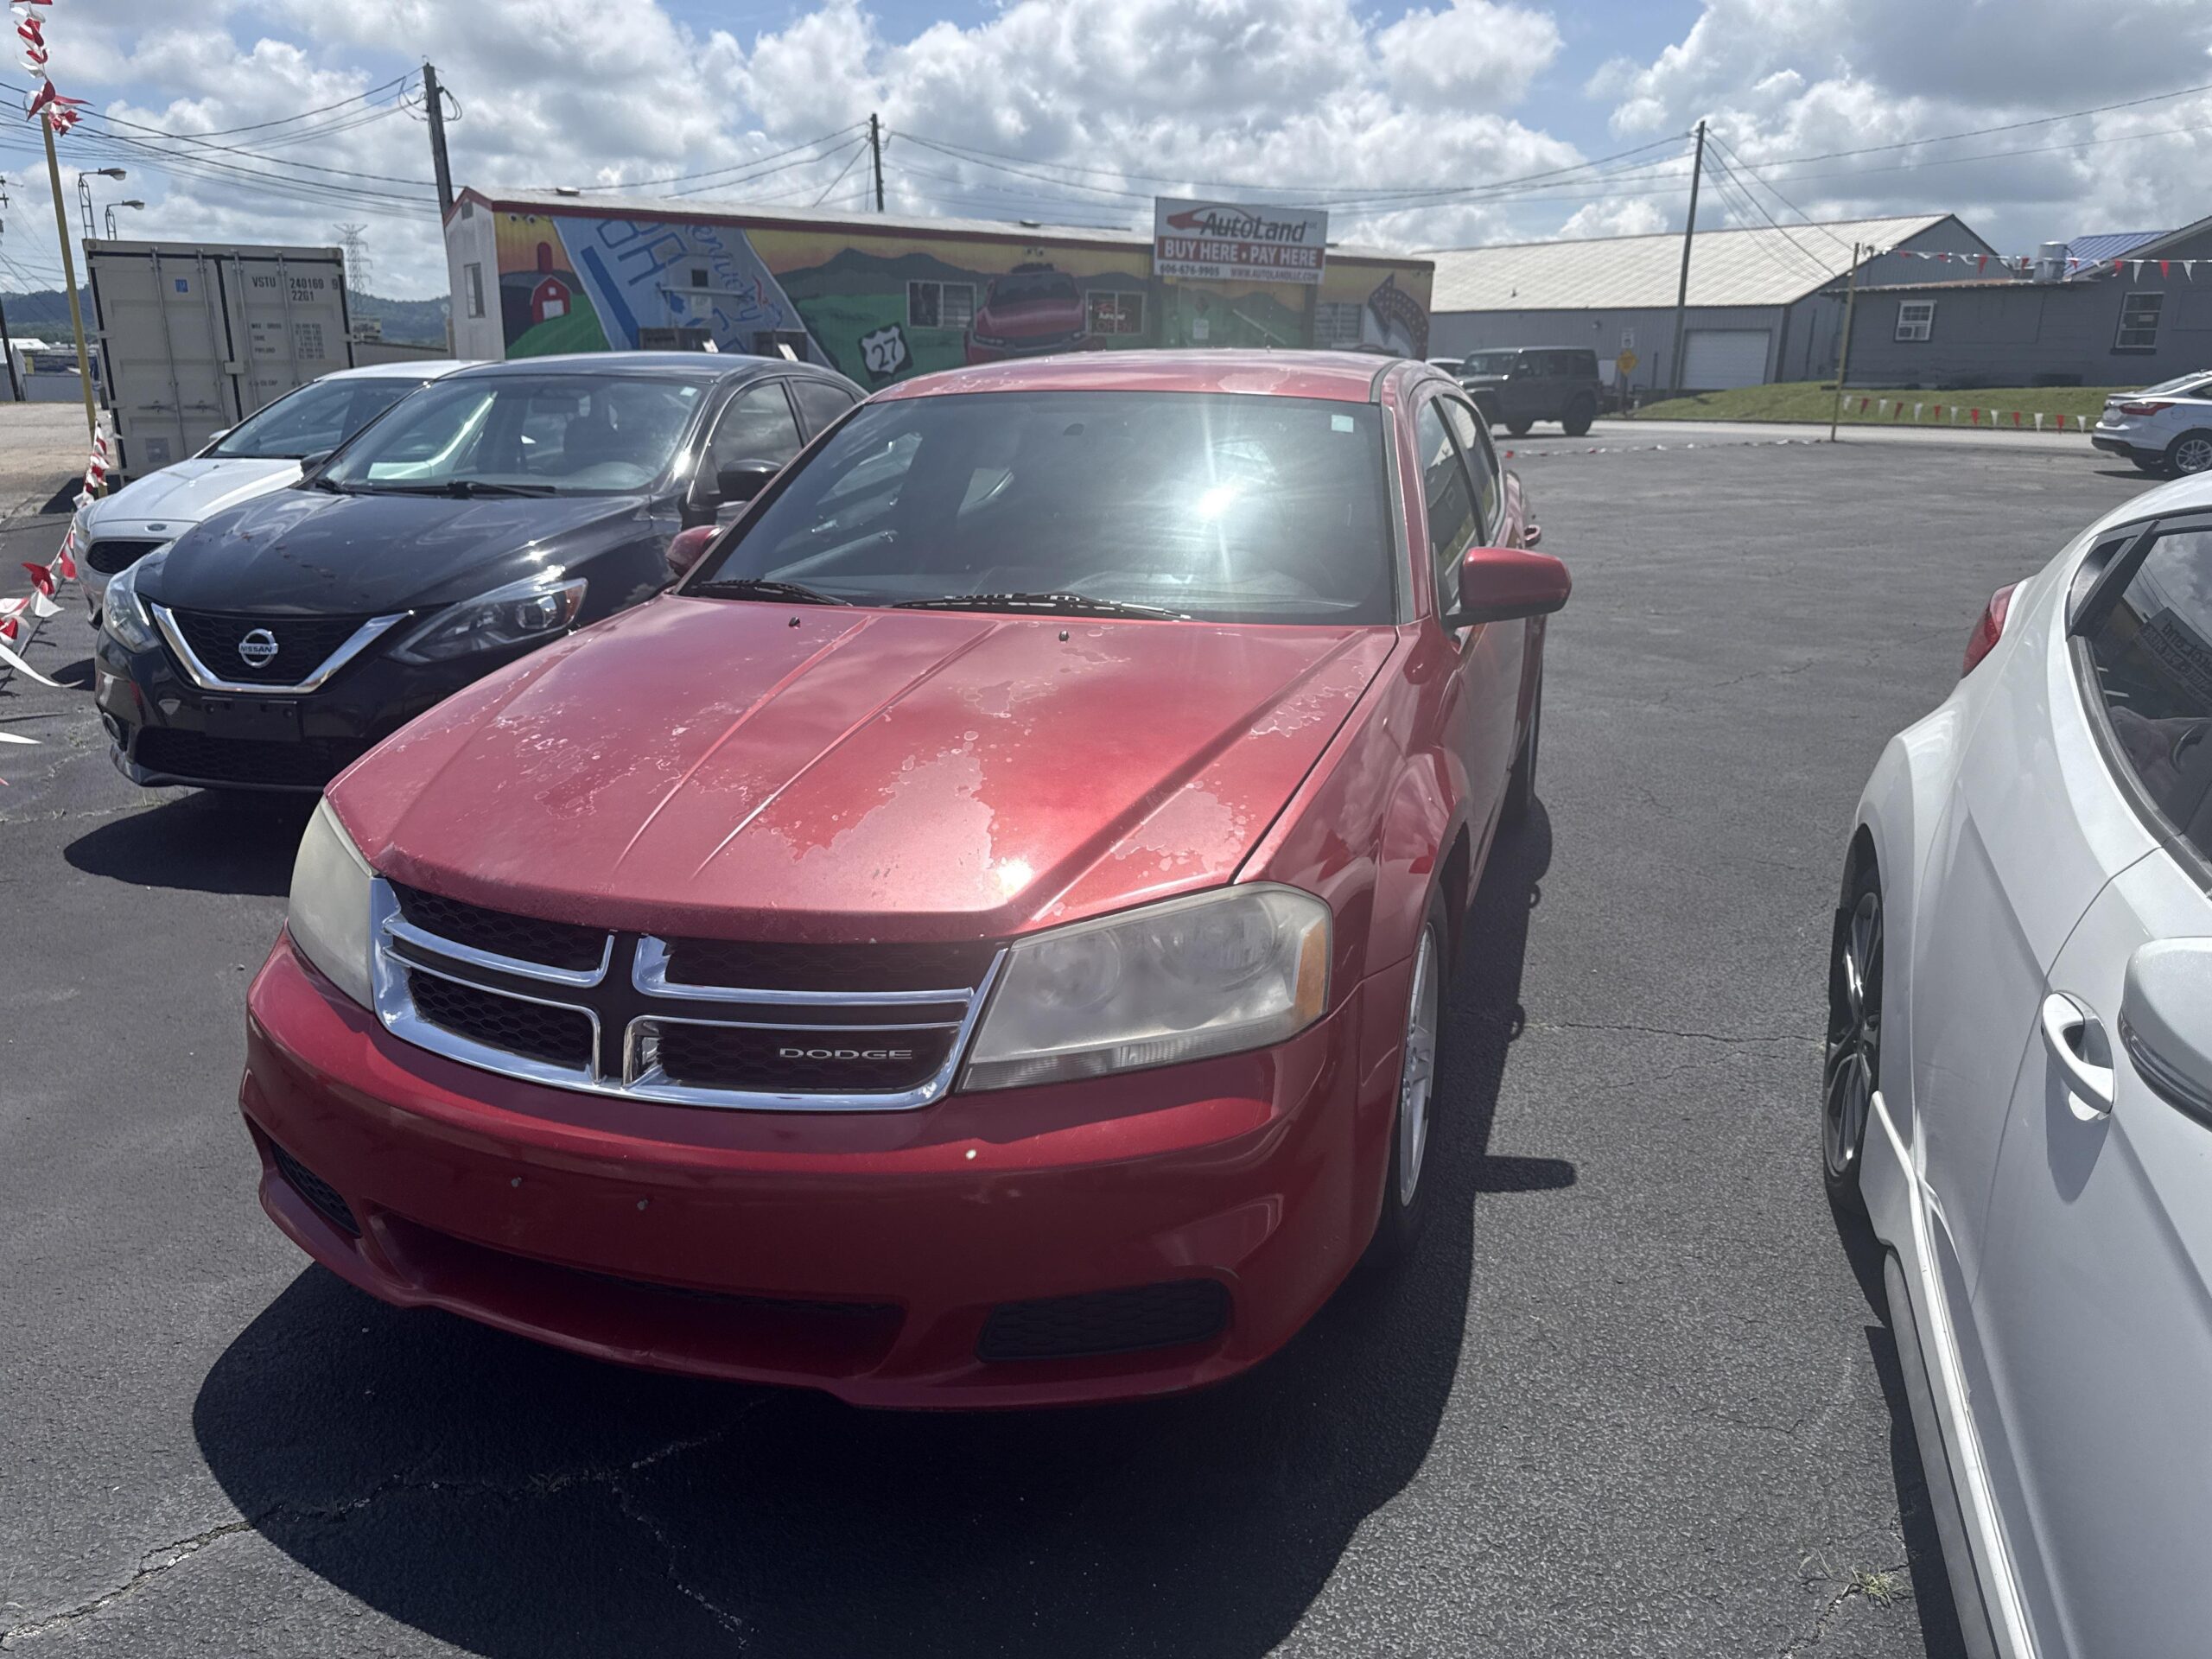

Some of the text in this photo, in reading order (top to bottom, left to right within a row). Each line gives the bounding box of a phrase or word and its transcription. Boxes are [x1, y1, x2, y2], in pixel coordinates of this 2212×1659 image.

[1199, 213, 1306, 243] AutoLand
[1164, 239, 1317, 267] BUY HERE PAY HERE
[251, 276, 276, 288] VSTU
[291, 290, 315, 302] 22G1
[871, 336, 896, 369] 27
[779, 1047, 912, 1059] DODGE
